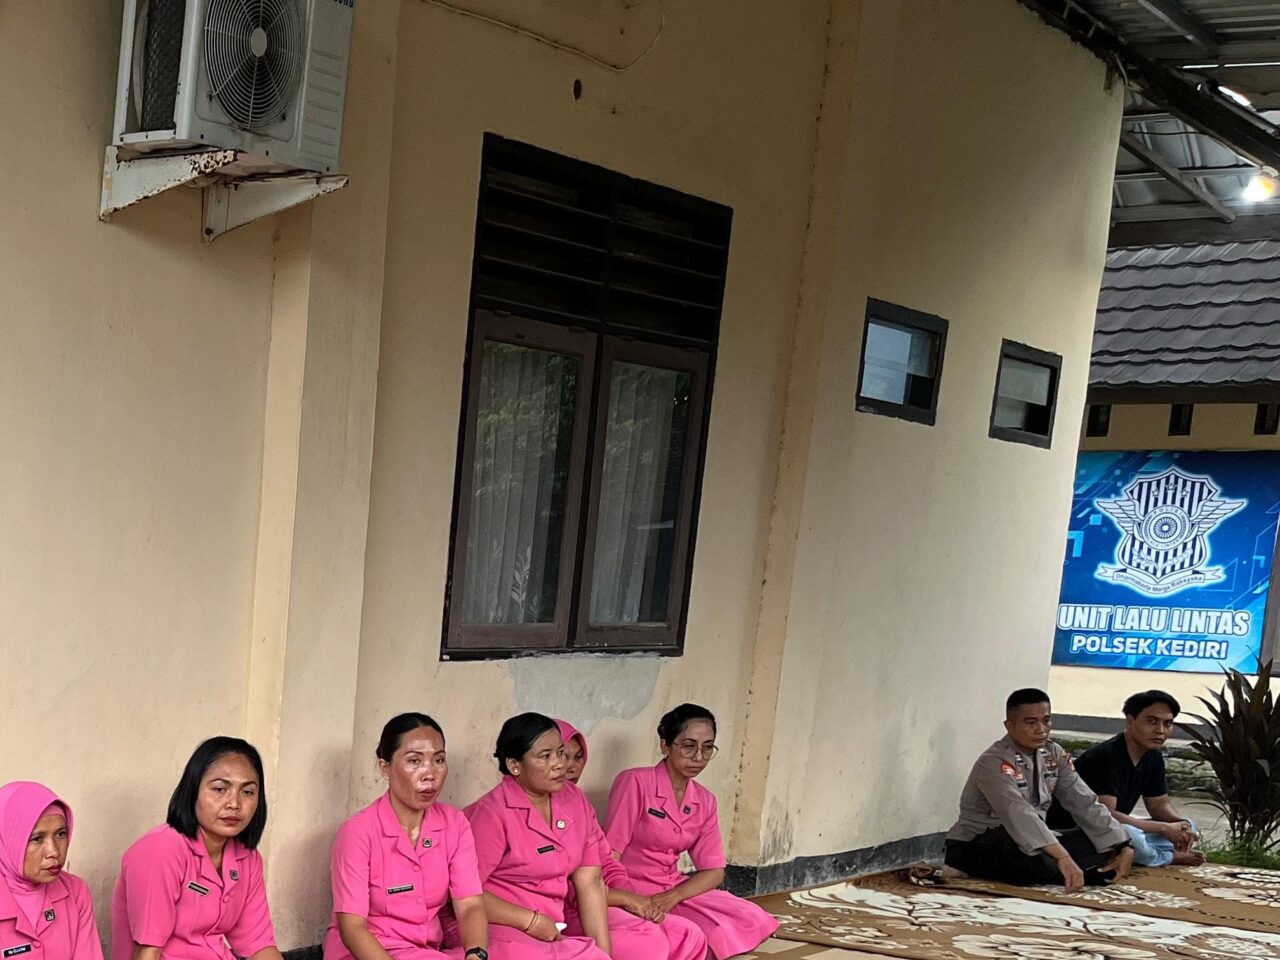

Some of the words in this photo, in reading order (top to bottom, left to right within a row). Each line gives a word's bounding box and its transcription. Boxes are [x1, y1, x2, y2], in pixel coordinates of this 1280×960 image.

[1058, 605, 1113, 629] UNIT
[1112, 606, 1169, 632] LALU
[1170, 608, 1250, 636] LINTAS
[1071, 635, 1152, 655] POLSEK
[1155, 637, 1229, 659] KEDIRI
